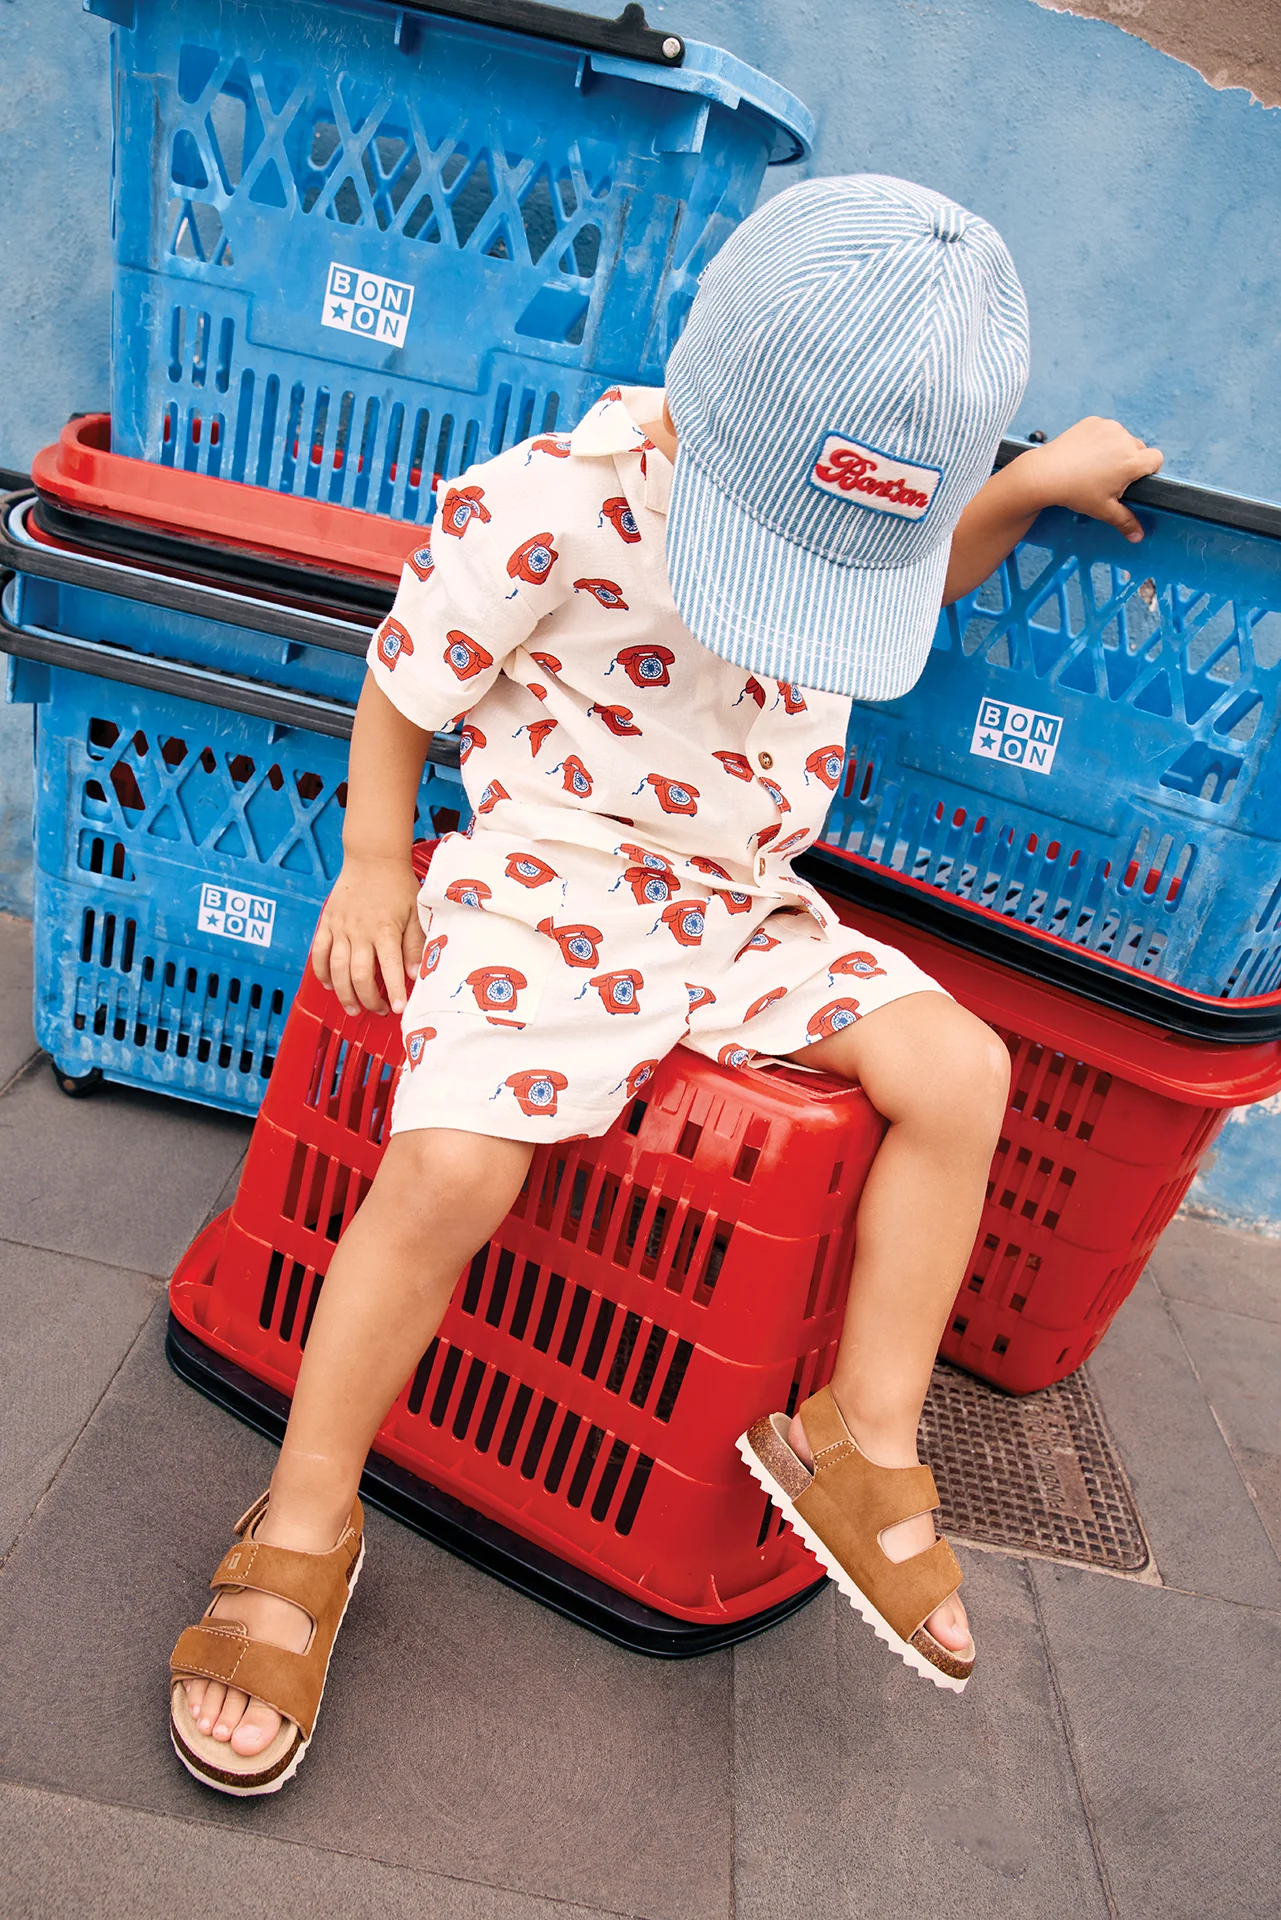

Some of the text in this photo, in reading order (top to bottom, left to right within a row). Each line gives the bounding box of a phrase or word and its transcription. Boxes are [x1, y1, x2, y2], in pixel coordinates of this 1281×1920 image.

[332, 270, 404, 311] BON
[355, 306, 400, 338] ON
[814, 447, 929, 508] Bonton
[983, 705, 1054, 742] BON
[1003, 738, 1047, 767] ON
[205, 889, 269, 919] BON
[226, 916, 265, 940] ON
